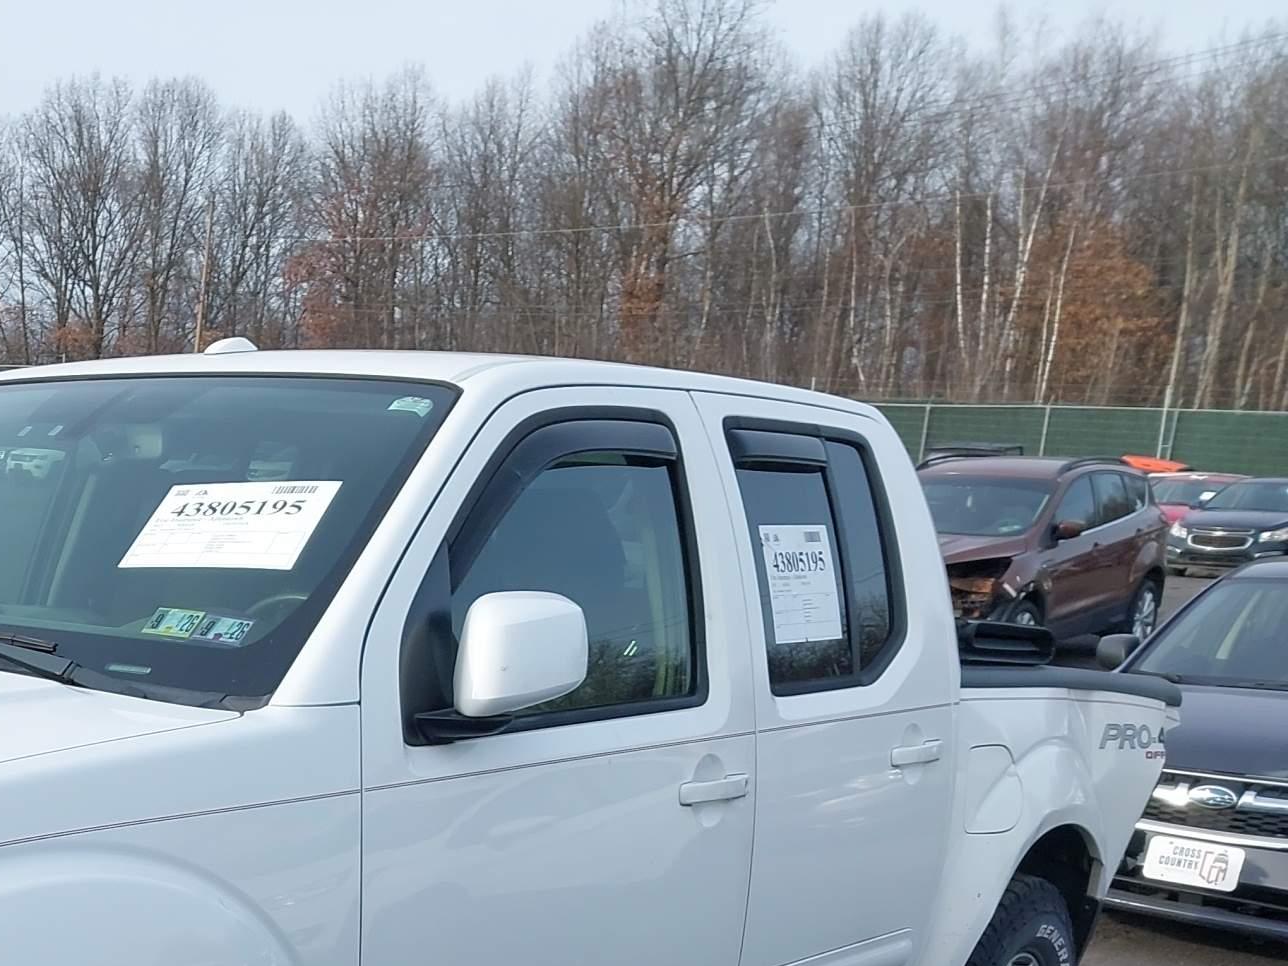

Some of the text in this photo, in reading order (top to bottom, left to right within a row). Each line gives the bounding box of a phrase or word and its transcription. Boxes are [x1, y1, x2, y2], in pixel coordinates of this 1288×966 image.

[170, 499, 307, 518] 43805195
[773, 551, 826, 573] 43805195
[1172, 846, 1203, 860] CROSS
[1158, 855, 1200, 871] COUNTRY
